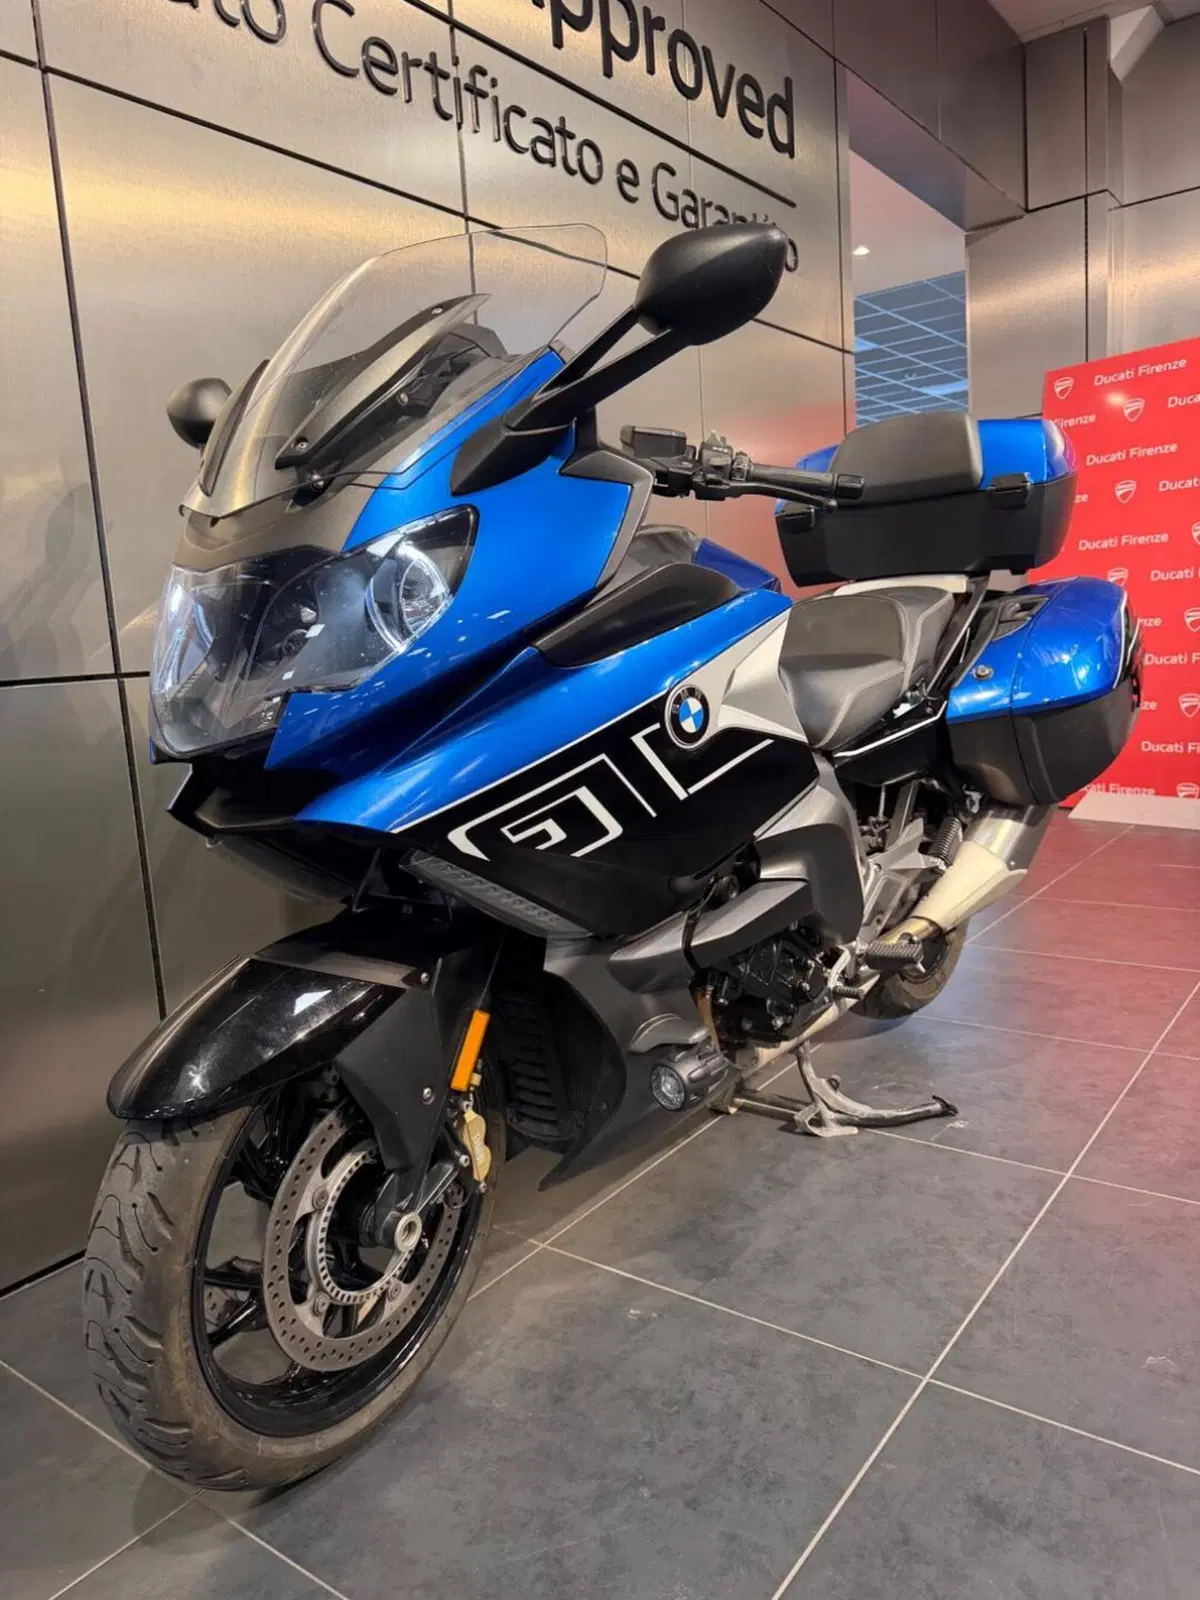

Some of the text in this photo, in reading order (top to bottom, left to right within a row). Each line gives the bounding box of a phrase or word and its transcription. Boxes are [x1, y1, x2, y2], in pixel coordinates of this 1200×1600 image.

[532, 0, 796, 159] pproved
[312, 0, 603, 185] Certificato
[616, 158, 640, 203] e
[1093, 367, 1135, 386] Ducati
[1138, 358, 1188, 377] Firenze
[1085, 443, 1178, 466] Ducati Firenze
[1078, 532, 1169, 551] Ducati Firenze
[1150, 566, 1195, 582] Ducati
[1143, 652, 1188, 666] Ducati
[1141, 740, 1184, 754] Ducati
